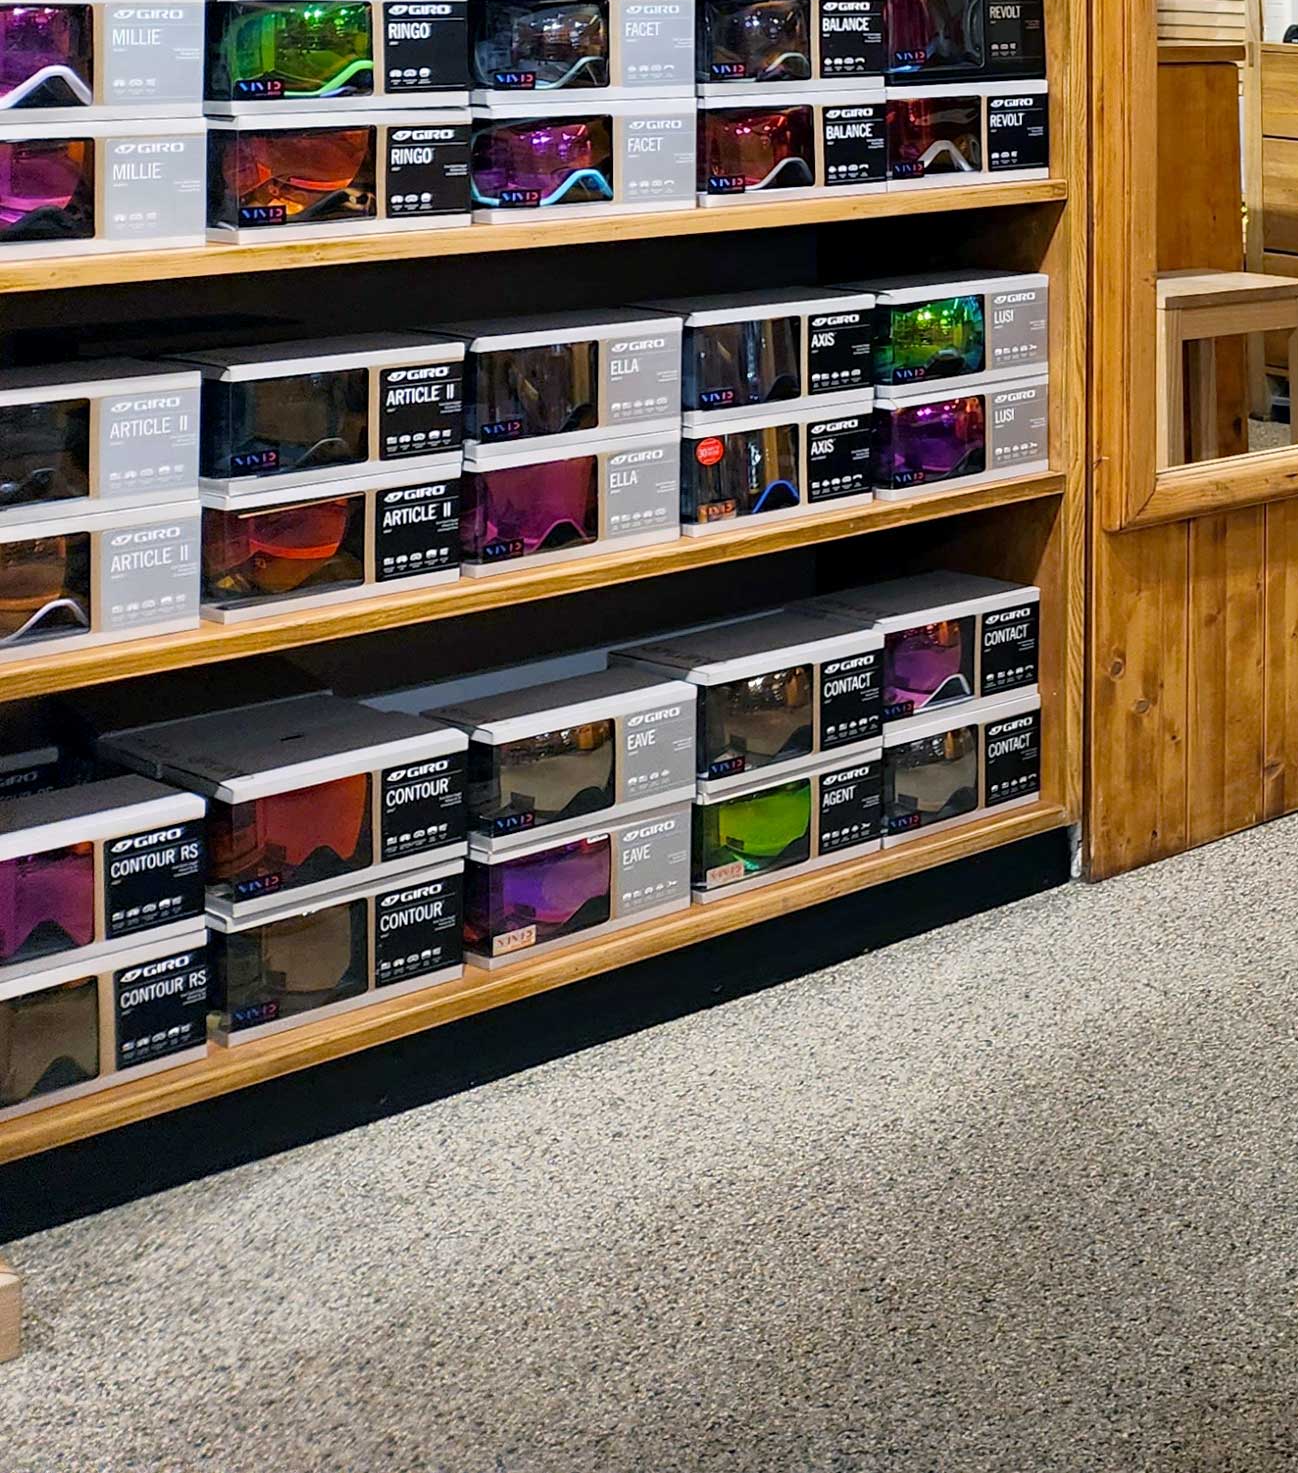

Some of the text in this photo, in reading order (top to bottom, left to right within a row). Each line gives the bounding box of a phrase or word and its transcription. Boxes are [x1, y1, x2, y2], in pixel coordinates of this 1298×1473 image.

[137, 9, 184, 20] GIRO
[408, 4, 452, 15] GIRO
[642, 4, 680, 14] GIRO
[838, 2, 871, 11] GIRO
[990, 5, 1020, 19] REVOLT
[388, 22, 430, 39] RINGO
[625, 22, 661, 37] FACET
[822, 17, 869, 31] BALANCE
[112, 29, 161, 46] MILLIE
[1004, 98, 1033, 106] GIRO
[841, 108, 874, 118] GIRO
[990, 113, 1024, 127] REVOLT
[645, 119, 682, 129] GIRO
[826, 124, 872, 139] BALANCE
[412, 129, 454, 141] GIRO
[137, 141, 185, 153] GIRO
[627, 137, 663, 152] FACET
[391, 148, 432, 165] RINGO
[113, 163, 161, 180] MILLIE
[1007, 292, 1036, 303] GIRO
[827, 314, 860, 326] GIRO
[994, 309, 1015, 324] LUSI
[628, 339, 665, 352] GIRO
[811, 332, 834, 348] AXIS
[406, 366, 449, 379] GIRO
[610, 359, 639, 376] ELLA
[386, 384, 454, 406] ARTICLE II
[1007, 389, 1036, 401] GIRO
[134, 397, 182, 411] GIRO
[994, 408, 1015, 424] LUSI
[110, 415, 188, 439] ARTICLE II
[826, 419, 859, 433] GIRO
[811, 439, 834, 455] AXIS
[628, 450, 664, 464] GIRO
[610, 471, 638, 488] ELLA
[404, 485, 446, 499] GIRO
[383, 502, 451, 527] ARTICLE II
[134, 527, 182, 543] GIRO
[111, 546, 189, 573] ARTICLE II
[1000, 607, 1031, 623] GIRO
[984, 624, 1028, 647] CONTACT
[839, 655, 875, 672] GIRO
[824, 673, 871, 698] CONTACT
[640, 707, 680, 722] GIRO
[1002, 716, 1033, 733] GIRO
[628, 730, 656, 750] EAVE
[988, 734, 1031, 758] CONTACT
[405, 760, 449, 778] GIRO
[836, 766, 869, 783] GIRO
[386, 778, 449, 807] CONTOUR
[822, 786, 856, 808] AGENT
[636, 820, 676, 839] GIRO
[134, 828, 182, 849] GIRO
[111, 843, 198, 878] CONTOUR RS
[623, 844, 650, 865] EAVE
[399, 883, 442, 903] GIRO
[380, 903, 443, 931] CONTOUR
[143, 955, 190, 976] GIRO
[120, 970, 206, 1009] CONTOUR RS
